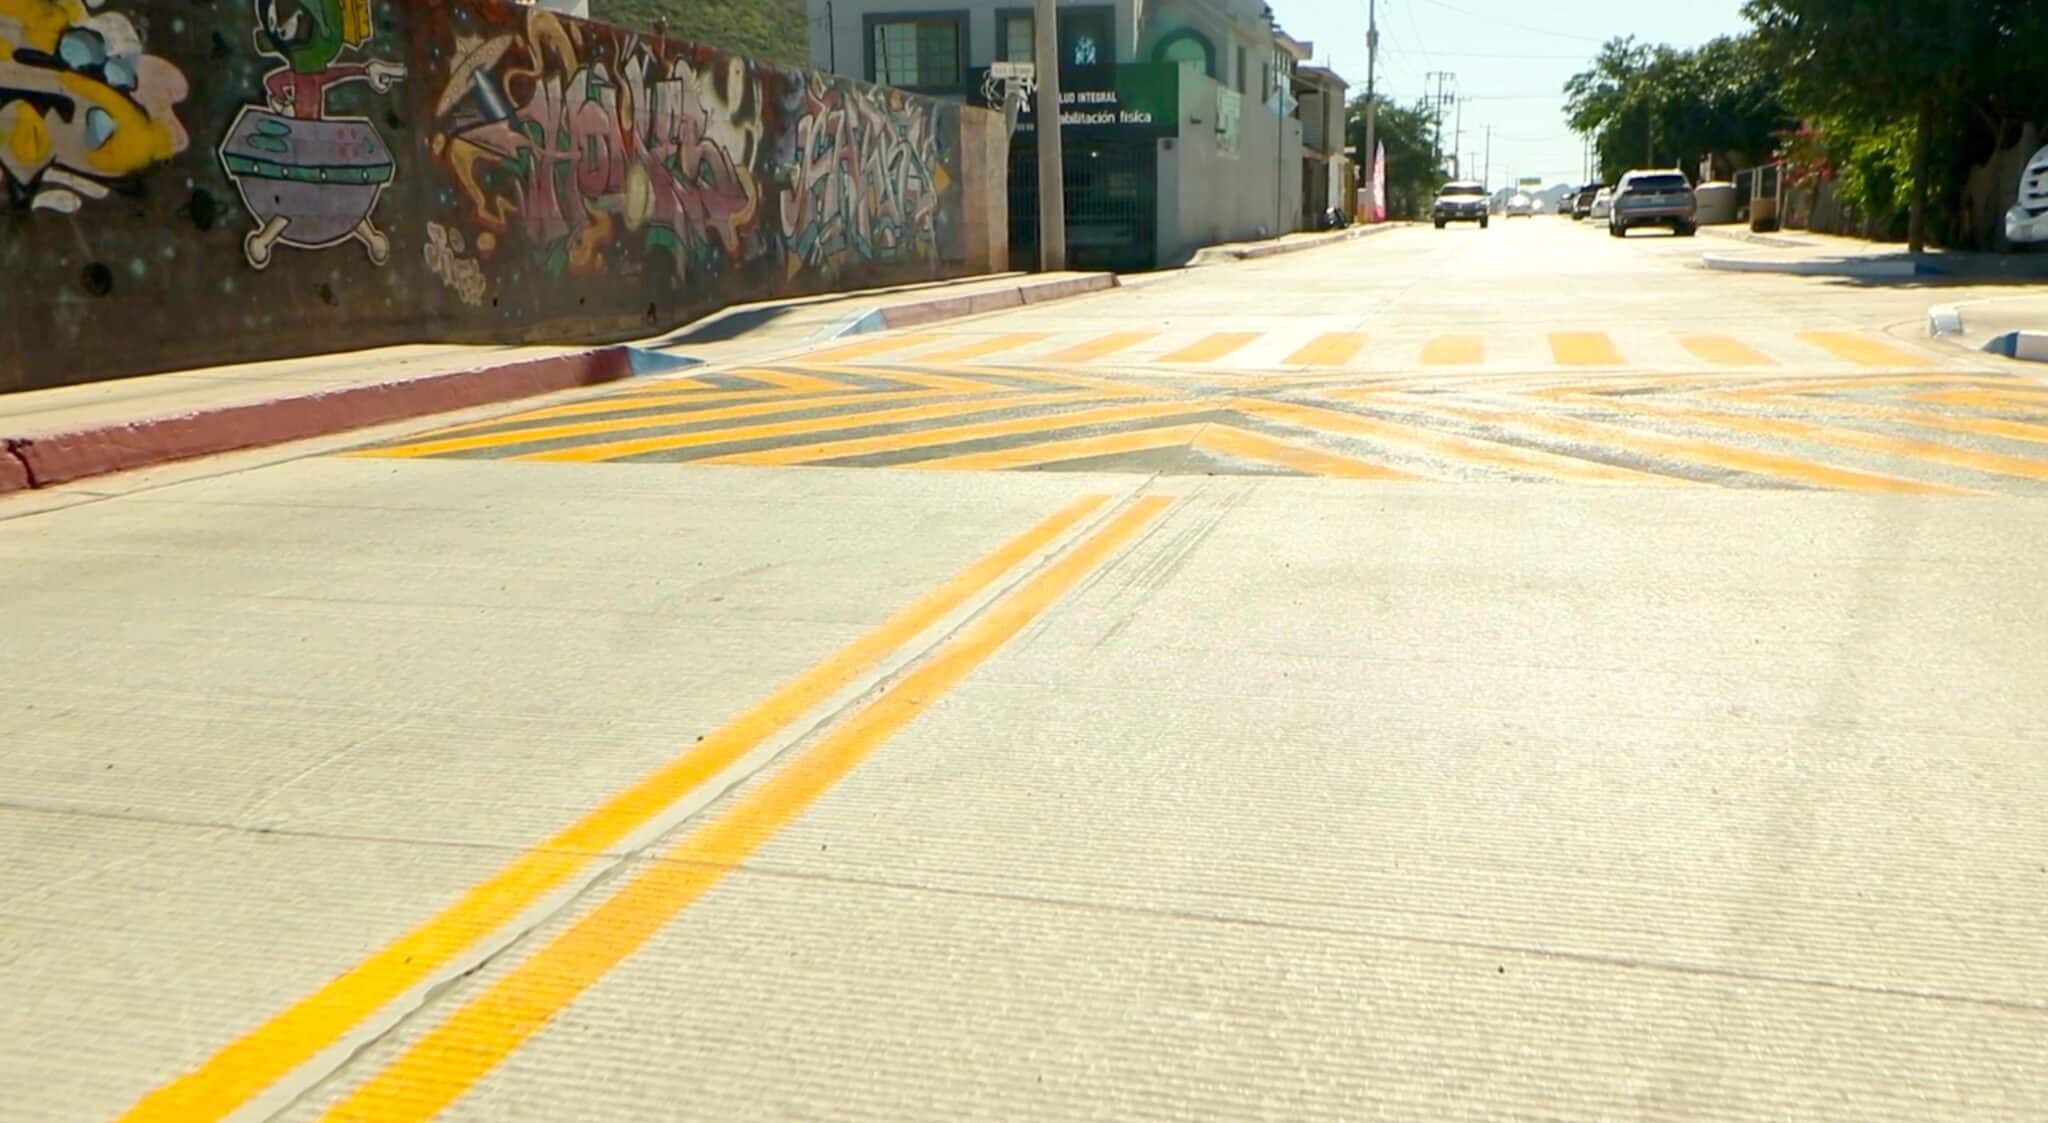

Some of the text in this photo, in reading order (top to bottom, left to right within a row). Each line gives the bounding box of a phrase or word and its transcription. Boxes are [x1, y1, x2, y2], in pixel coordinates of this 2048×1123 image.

[1059, 91, 1118, 104] LUD INTEGRAL
[1059, 109, 1116, 125] abilitación
